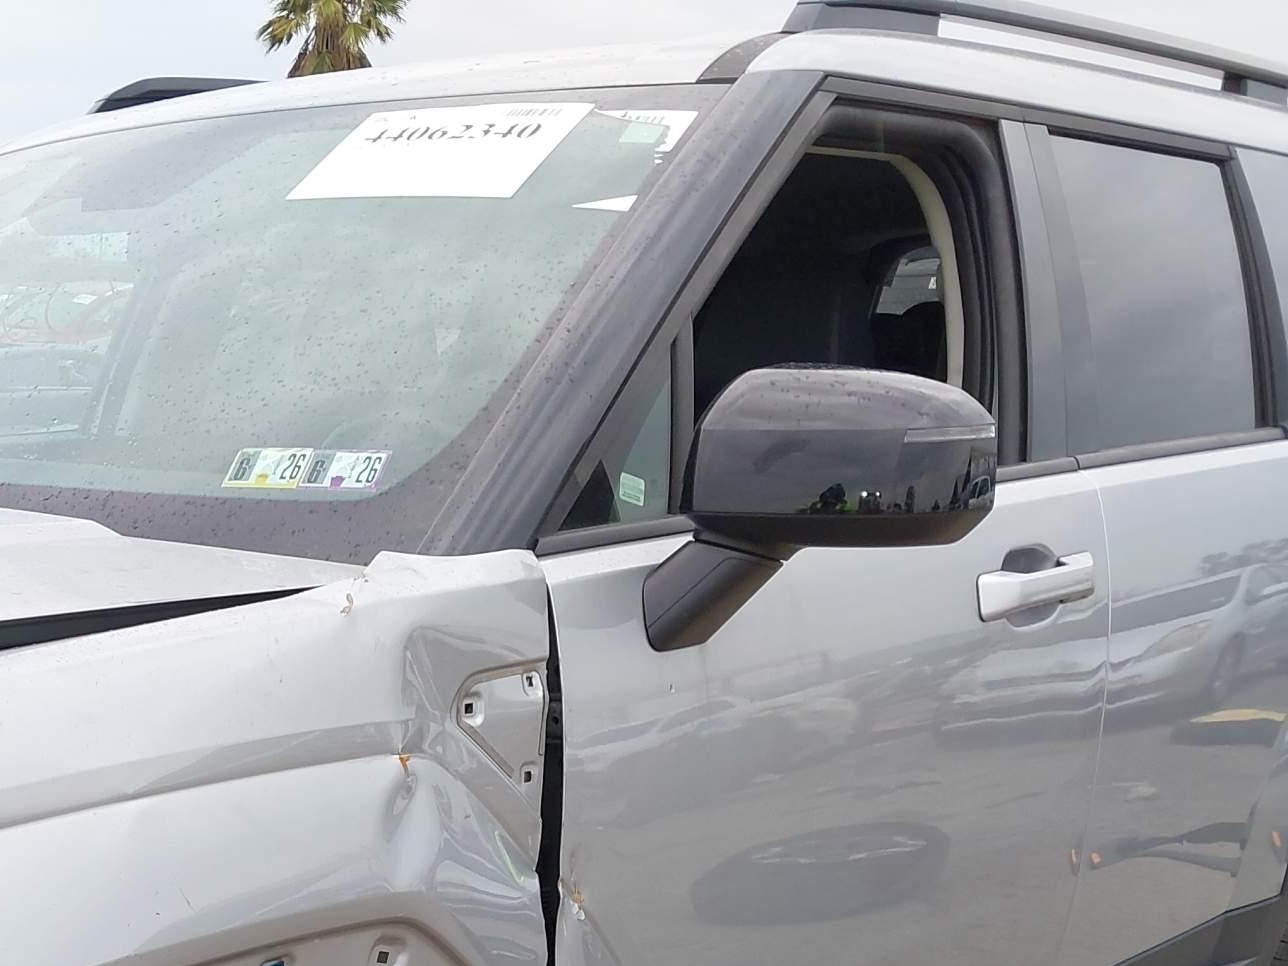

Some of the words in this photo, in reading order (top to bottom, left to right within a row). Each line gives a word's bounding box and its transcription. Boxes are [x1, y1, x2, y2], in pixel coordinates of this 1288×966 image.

[365, 123, 542, 142] 44062340
[233, 457, 251, 481] 6
[279, 453, 307, 482] 26
[307, 459, 326, 484] 6
[355, 455, 383, 484] 26
